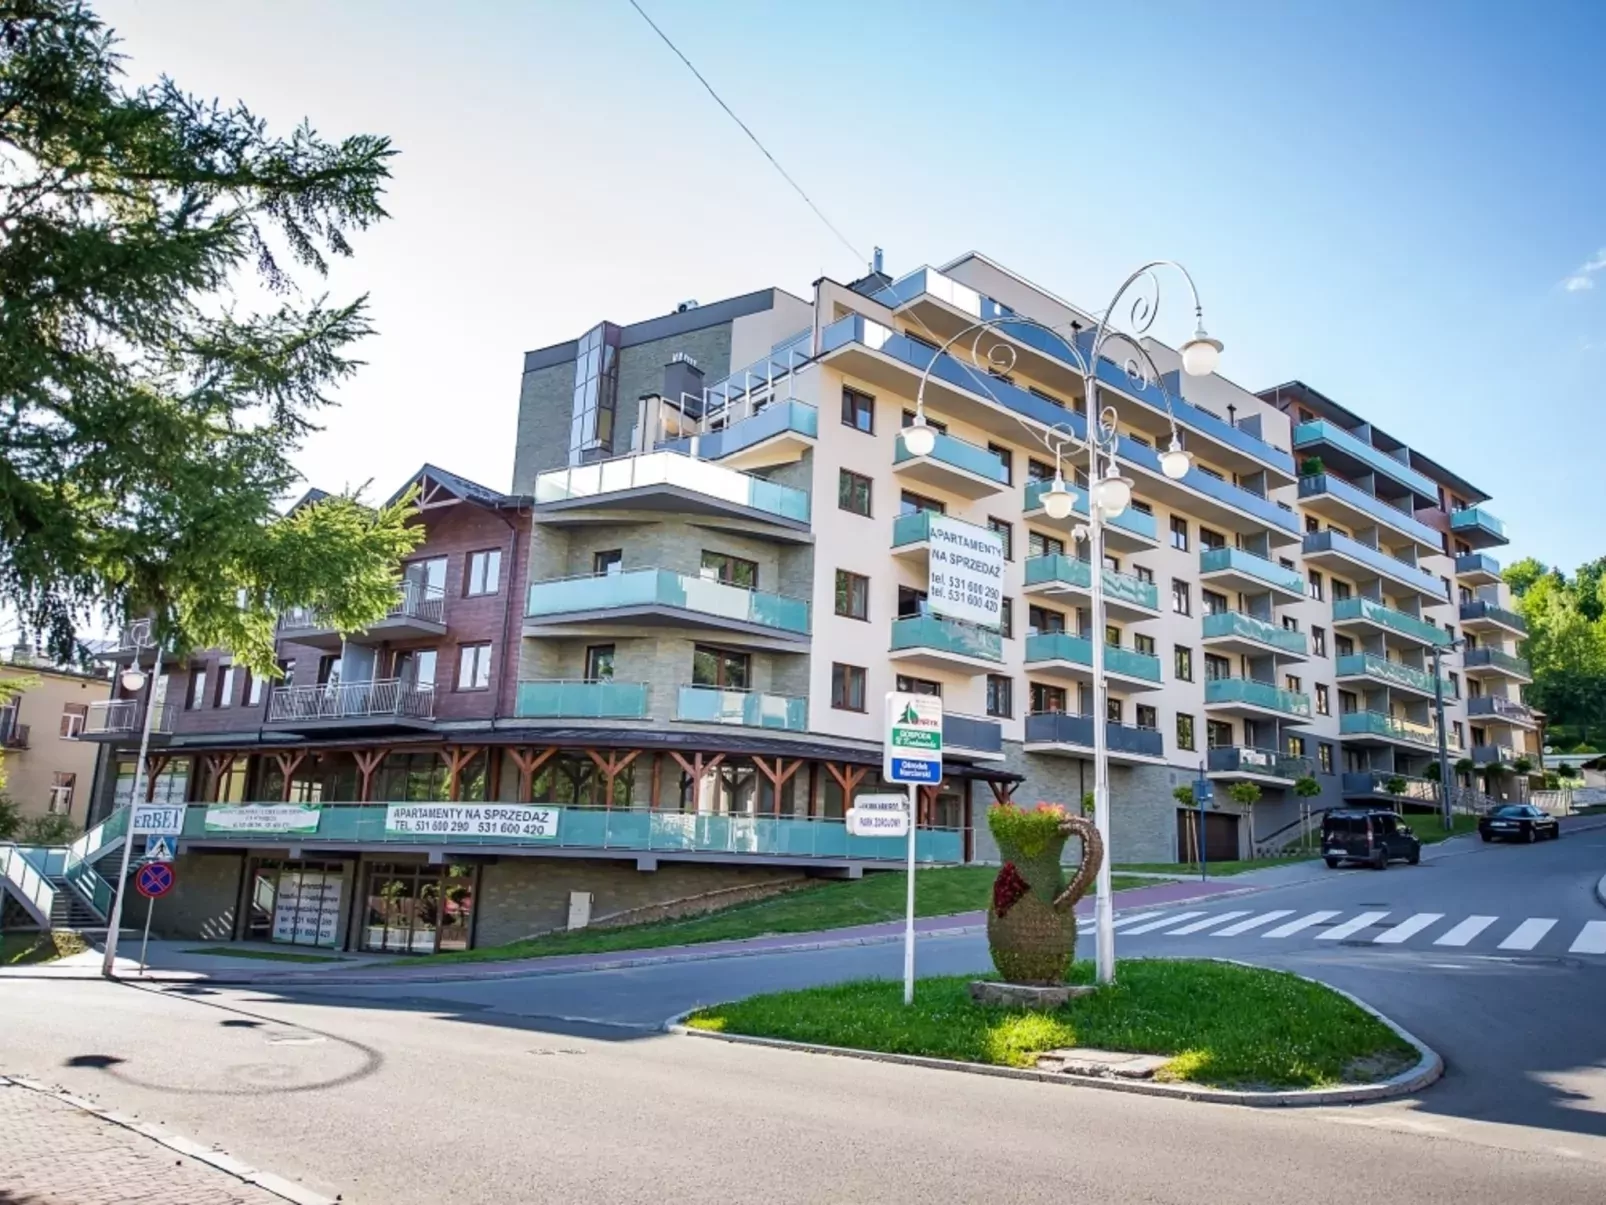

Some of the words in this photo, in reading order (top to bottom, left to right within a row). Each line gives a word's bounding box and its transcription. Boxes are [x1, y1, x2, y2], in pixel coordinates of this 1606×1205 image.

[930, 528, 1001, 556] APARTAMENTY
[932, 549, 947, 562] NA
[949, 552, 1001, 578] SPRZEDAŻ
[931, 572, 945, 585] tel.
[949, 576, 965, 590] 531
[985, 586, 999, 599] 290
[931, 586, 945, 598] tel.
[948, 589, 965, 602] 531
[967, 594, 982, 608] 600
[984, 599, 998, 613] 420
[394, 807, 462, 819] APARTAMENTY
[465, 809, 481, 820] NA
[484, 809, 549, 823] SPRZEDAŻ
[395, 820, 412, 830] TEL.
[415, 820, 430, 831] 531
[432, 820, 448, 831] 600
[451, 821, 469, 832] 290
[478, 822, 497, 833] 531
[501, 823, 520, 834] 600
[523, 824, 544, 835] 420
